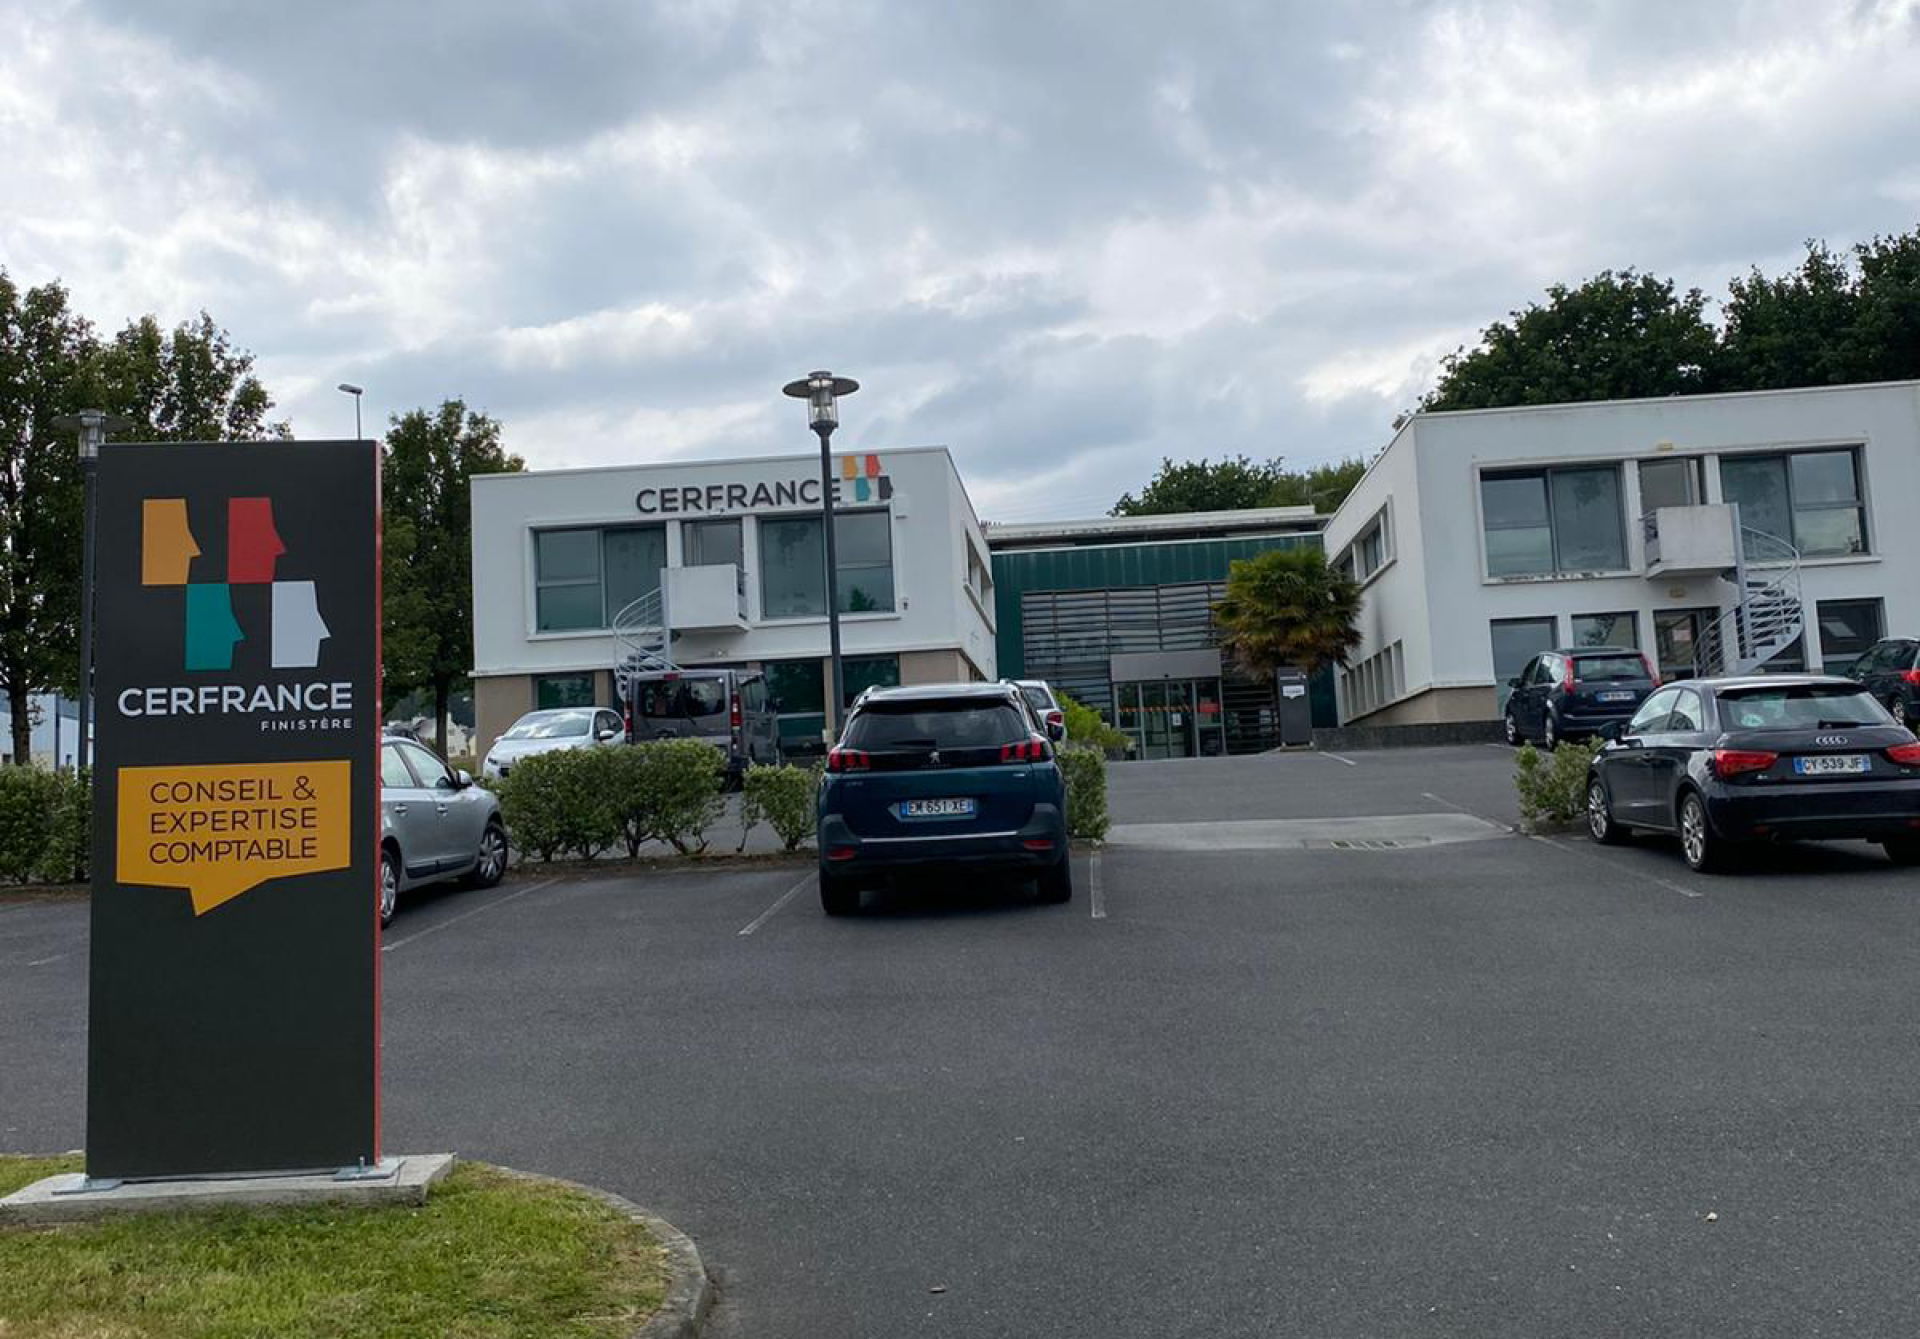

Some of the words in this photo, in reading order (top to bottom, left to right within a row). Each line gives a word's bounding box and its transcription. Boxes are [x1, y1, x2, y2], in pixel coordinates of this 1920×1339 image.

[636, 478, 841, 513] CERFRANCE
[118, 682, 353, 716] CERFRANCE
[260, 717, 353, 732] FINISTÈRE
[150, 779, 283, 804] CONSEIL
[292, 775, 317, 800] &
[150, 807, 318, 834] EXPERTISE
[149, 837, 318, 865] COMPTABLE
